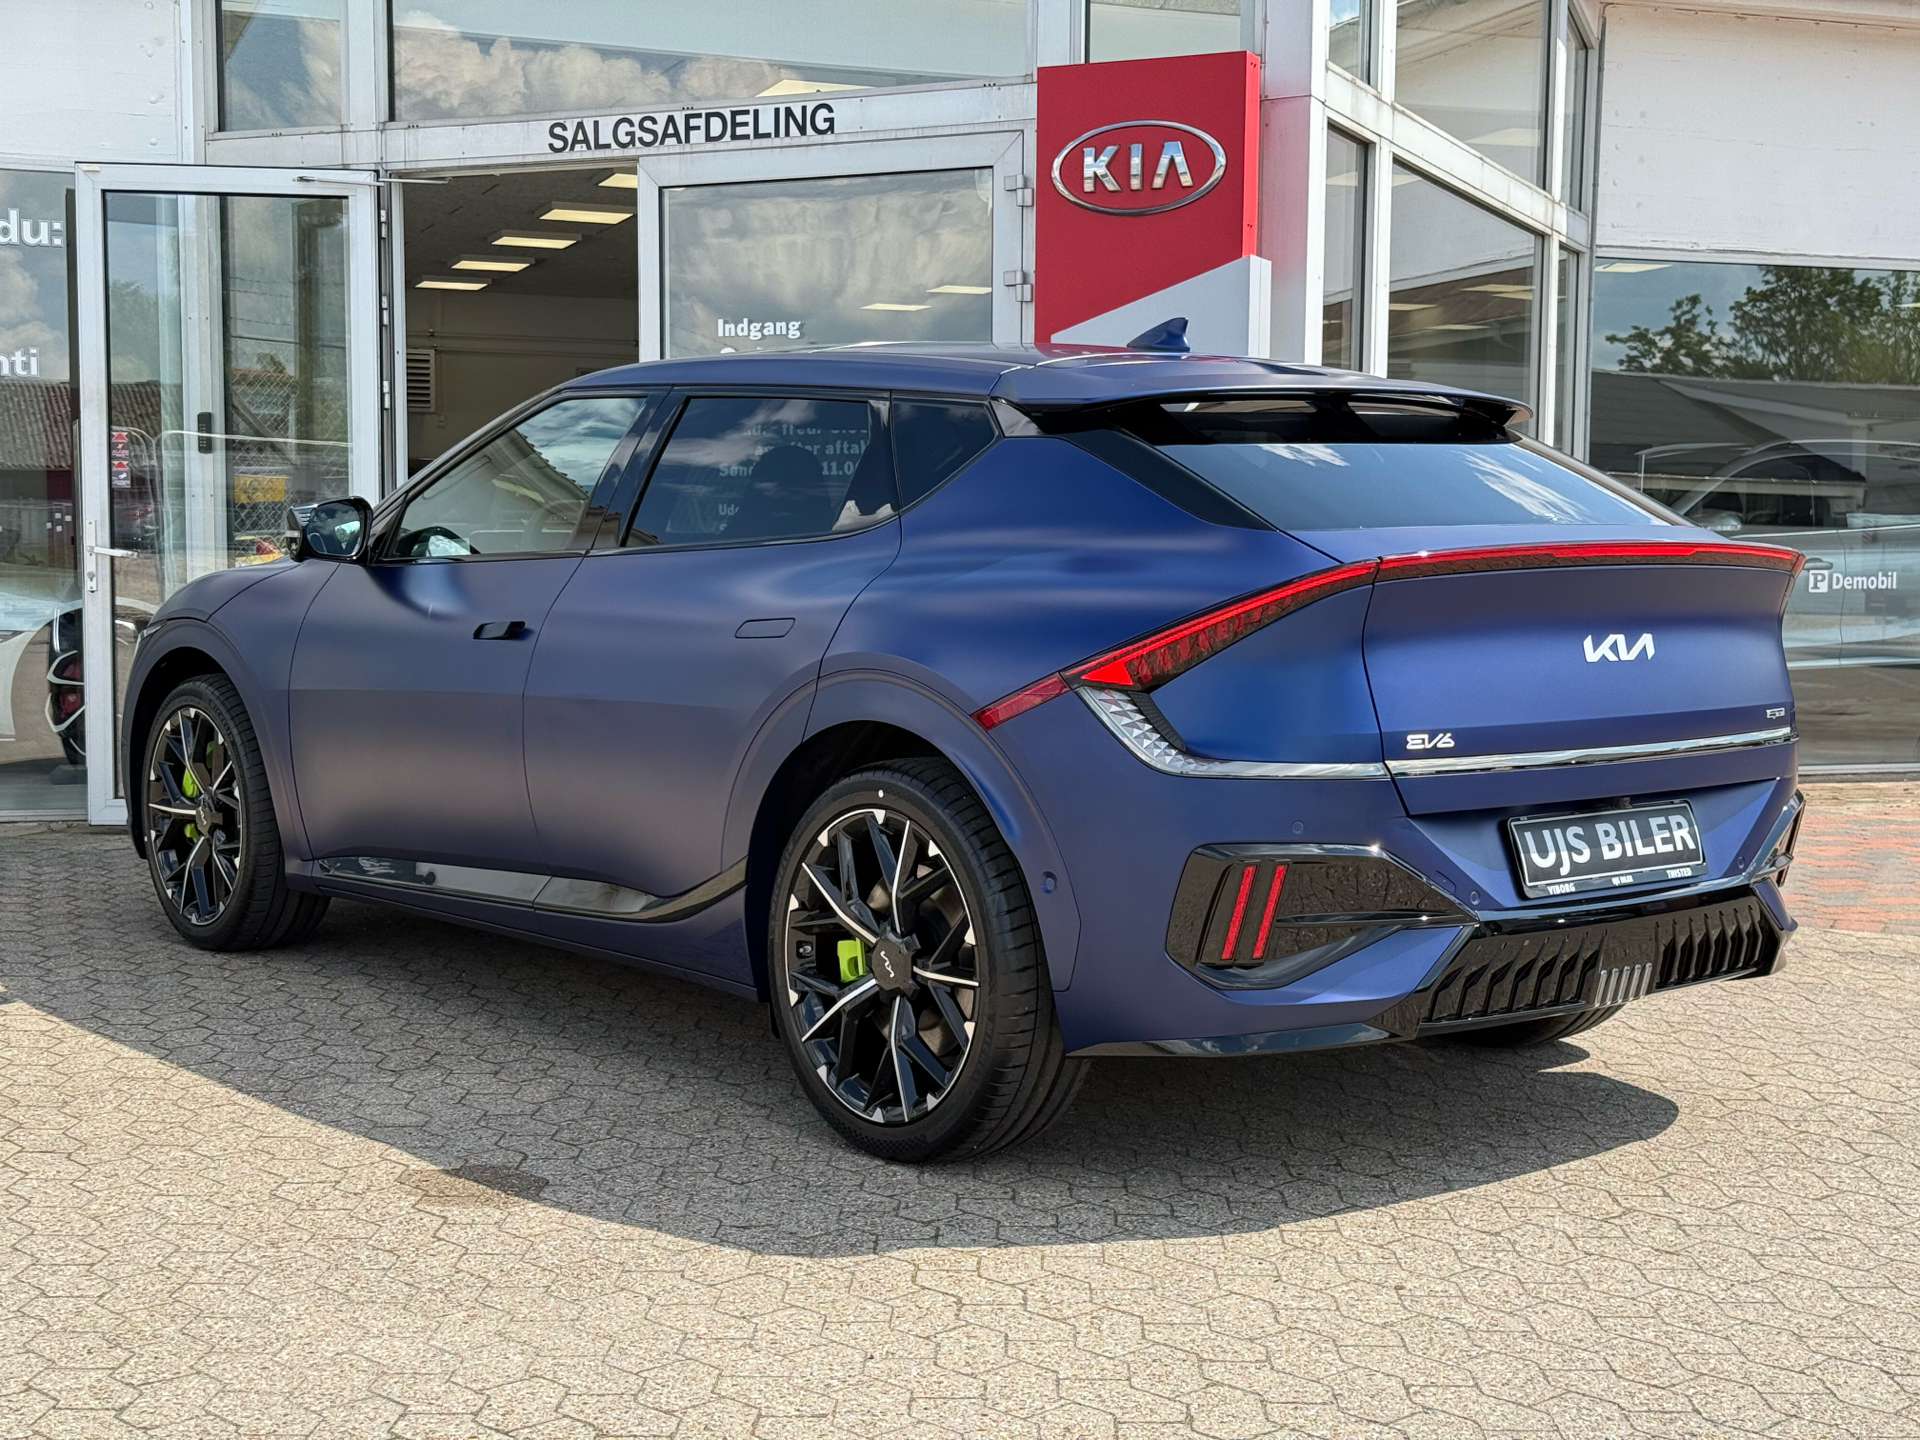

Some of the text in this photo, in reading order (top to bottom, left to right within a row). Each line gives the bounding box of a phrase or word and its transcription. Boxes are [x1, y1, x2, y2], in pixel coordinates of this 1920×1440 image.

[547, 102, 836, 154] SALGSAFDELING
[1082, 140, 1194, 193] KIA
[717, 317, 801, 340] Indgang
[1832, 571, 1897, 590] Demobil
[1583, 632, 1655, 663] KIA
[1406, 732, 1455, 750] EV6
[1595, 814, 1697, 861] BILER
[1666, 867, 1693, 879] THISTED
[1547, 883, 1576, 896] VIBORG
